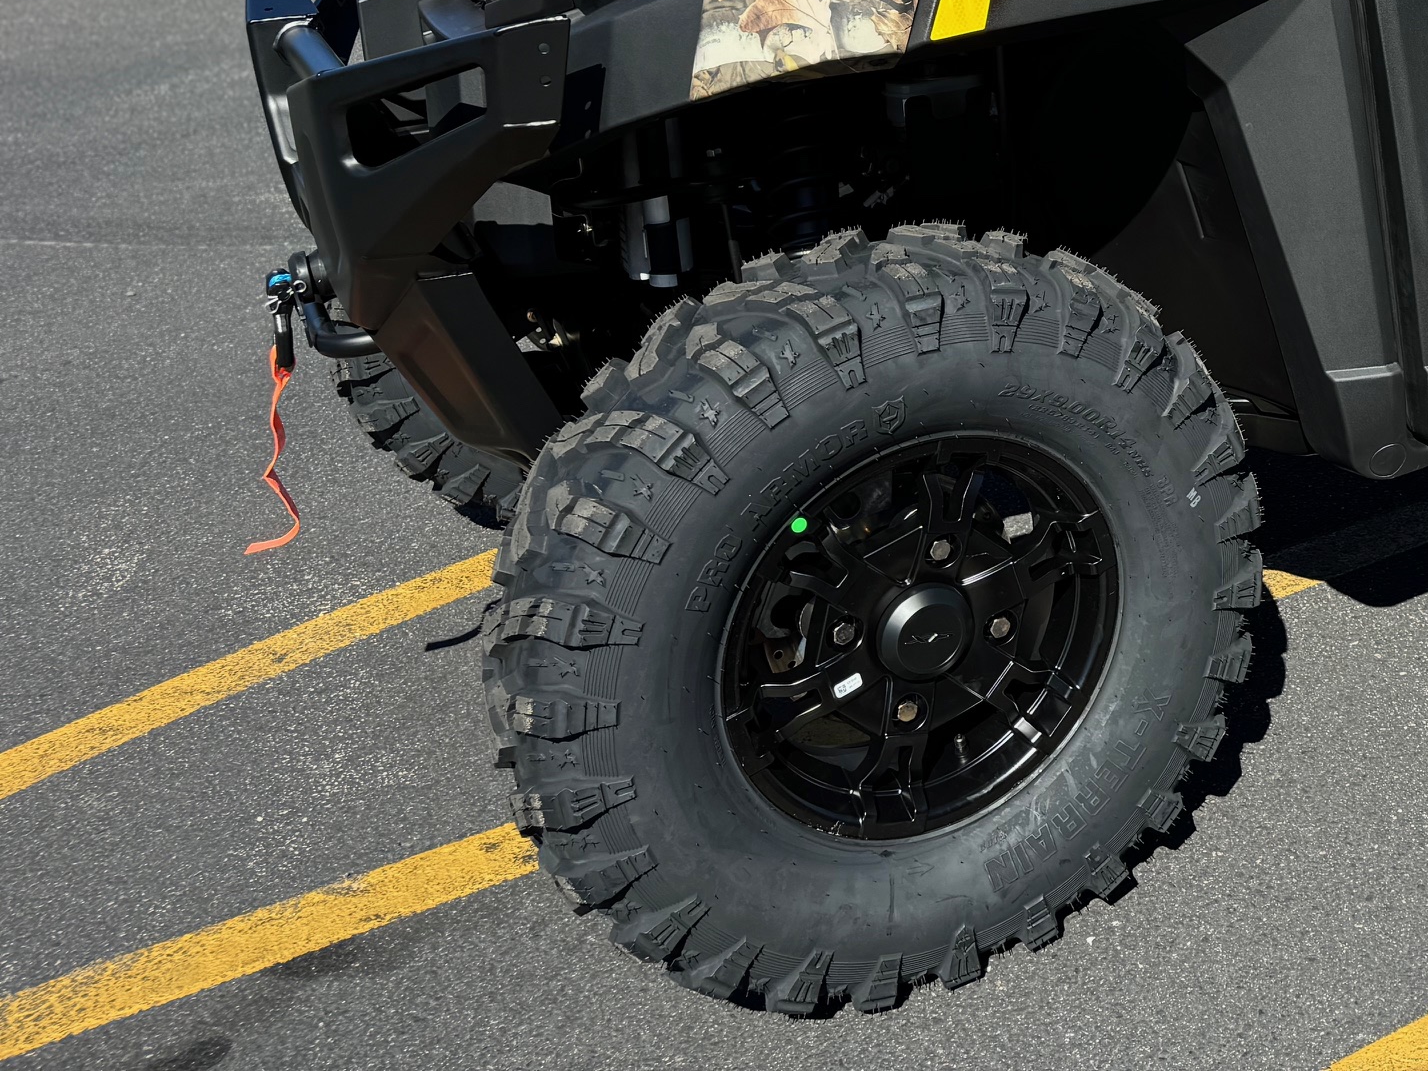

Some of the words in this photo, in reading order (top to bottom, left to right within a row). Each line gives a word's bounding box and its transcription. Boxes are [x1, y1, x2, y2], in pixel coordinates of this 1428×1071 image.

[684, 533, 742, 613] PRO
[740, 418, 869, 533] ARMOR
[1186, 486, 1202, 509] MB
[982, 685, 1173, 894] X-TERRAIN
